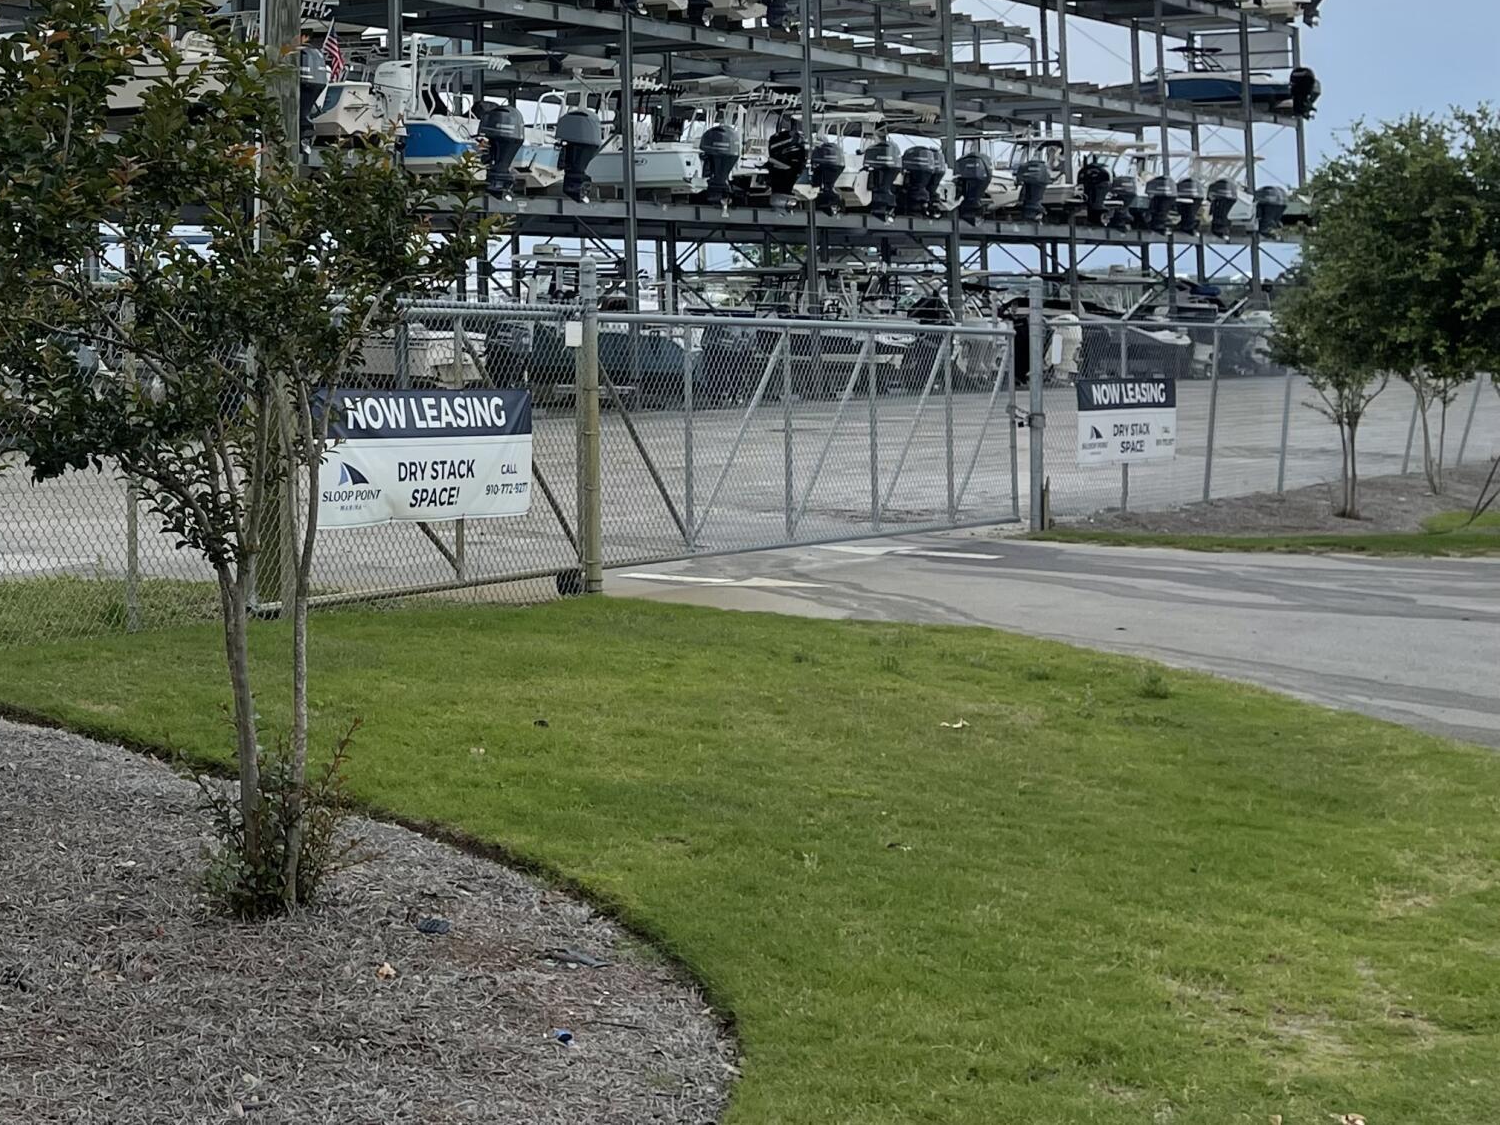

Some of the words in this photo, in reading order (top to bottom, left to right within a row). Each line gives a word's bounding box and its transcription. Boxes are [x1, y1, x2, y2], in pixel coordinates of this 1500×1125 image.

[1092, 383, 1120, 405] NOW
[1121, 382, 1166, 404] LEASING
[344, 396, 406, 430] NOW
[409, 396, 506, 429] LEASING
[1113, 423, 1129, 437] DRY
[1130, 422, 1151, 436] STACK
[398, 461, 428, 482] DRY
[430, 459, 476, 480] STACK
[501, 463, 518, 475] CALL
[322, 490, 355, 503] SLOOP
[355, 488, 382, 501] POINT
[409, 486, 460, 508] SPACE!
[485, 482, 529, 496] 910-772-9277
